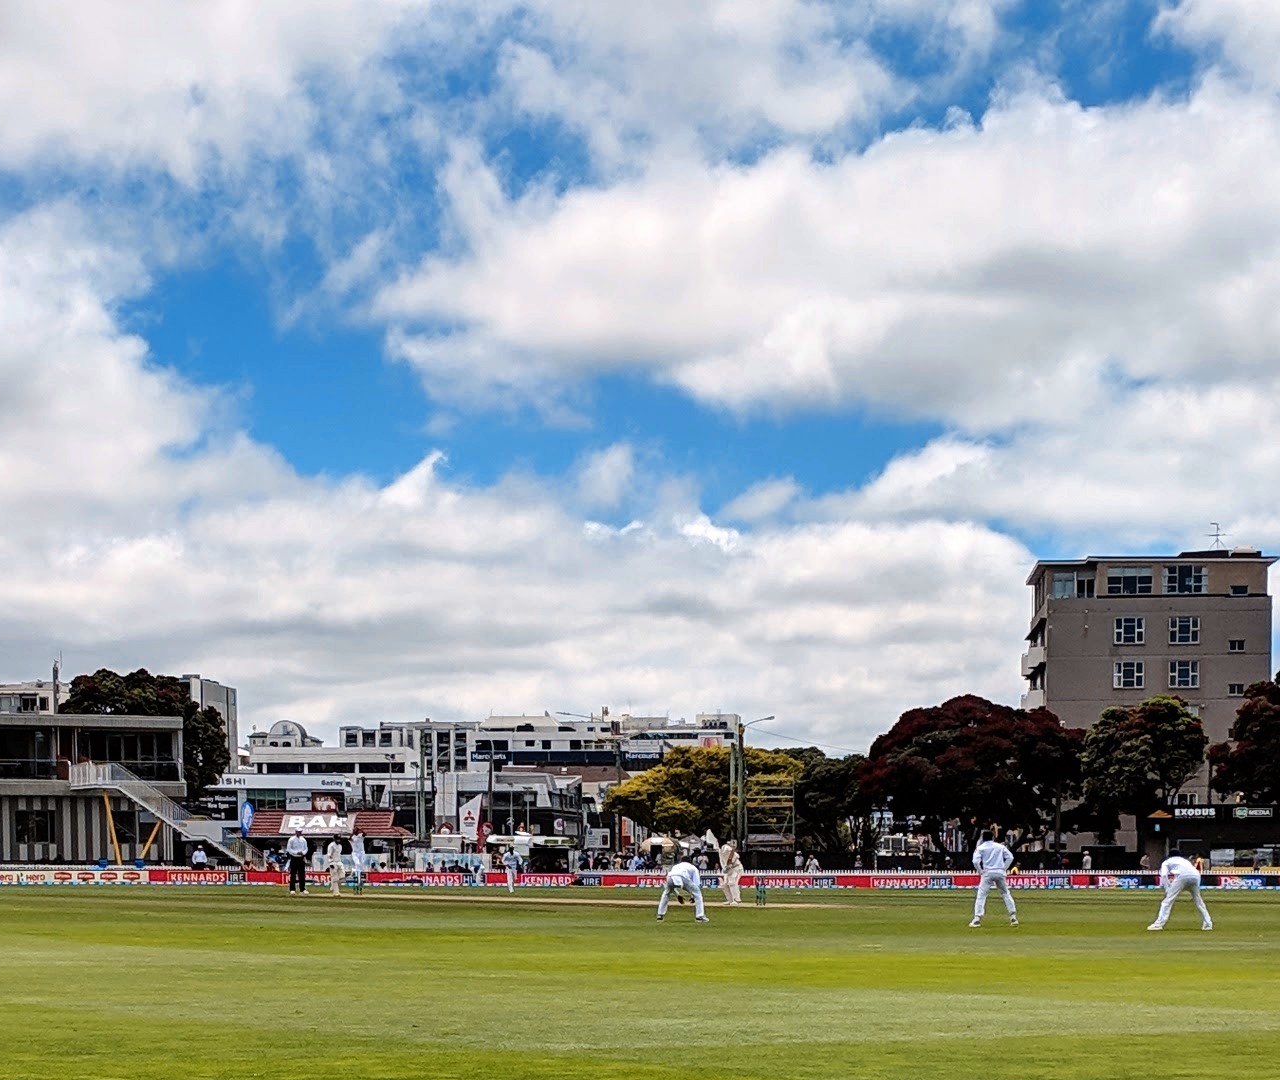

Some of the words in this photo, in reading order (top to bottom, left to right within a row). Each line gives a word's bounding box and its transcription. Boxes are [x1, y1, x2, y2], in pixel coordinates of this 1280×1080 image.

[472, 752, 507, 760] Harcurts
[625, 752, 660, 760] Harcourts
[220, 777, 246, 785] ISHI
[1174, 808, 1216, 816] EXODUS
[288, 815, 348, 828] BAR
[170, 873, 226, 882] KENNARDS
[230, 873, 244, 881] IRE
[524, 876, 573, 885] KENNARD
[874, 877, 927, 887] KENNARDS
[930, 878, 951, 887] HIRE
[1049, 877, 1069, 886] HIRE
[1098, 876, 1138, 887] Resene
[1220, 876, 1263, 888] Resene
[813, 878, 834, 887] HIRE
